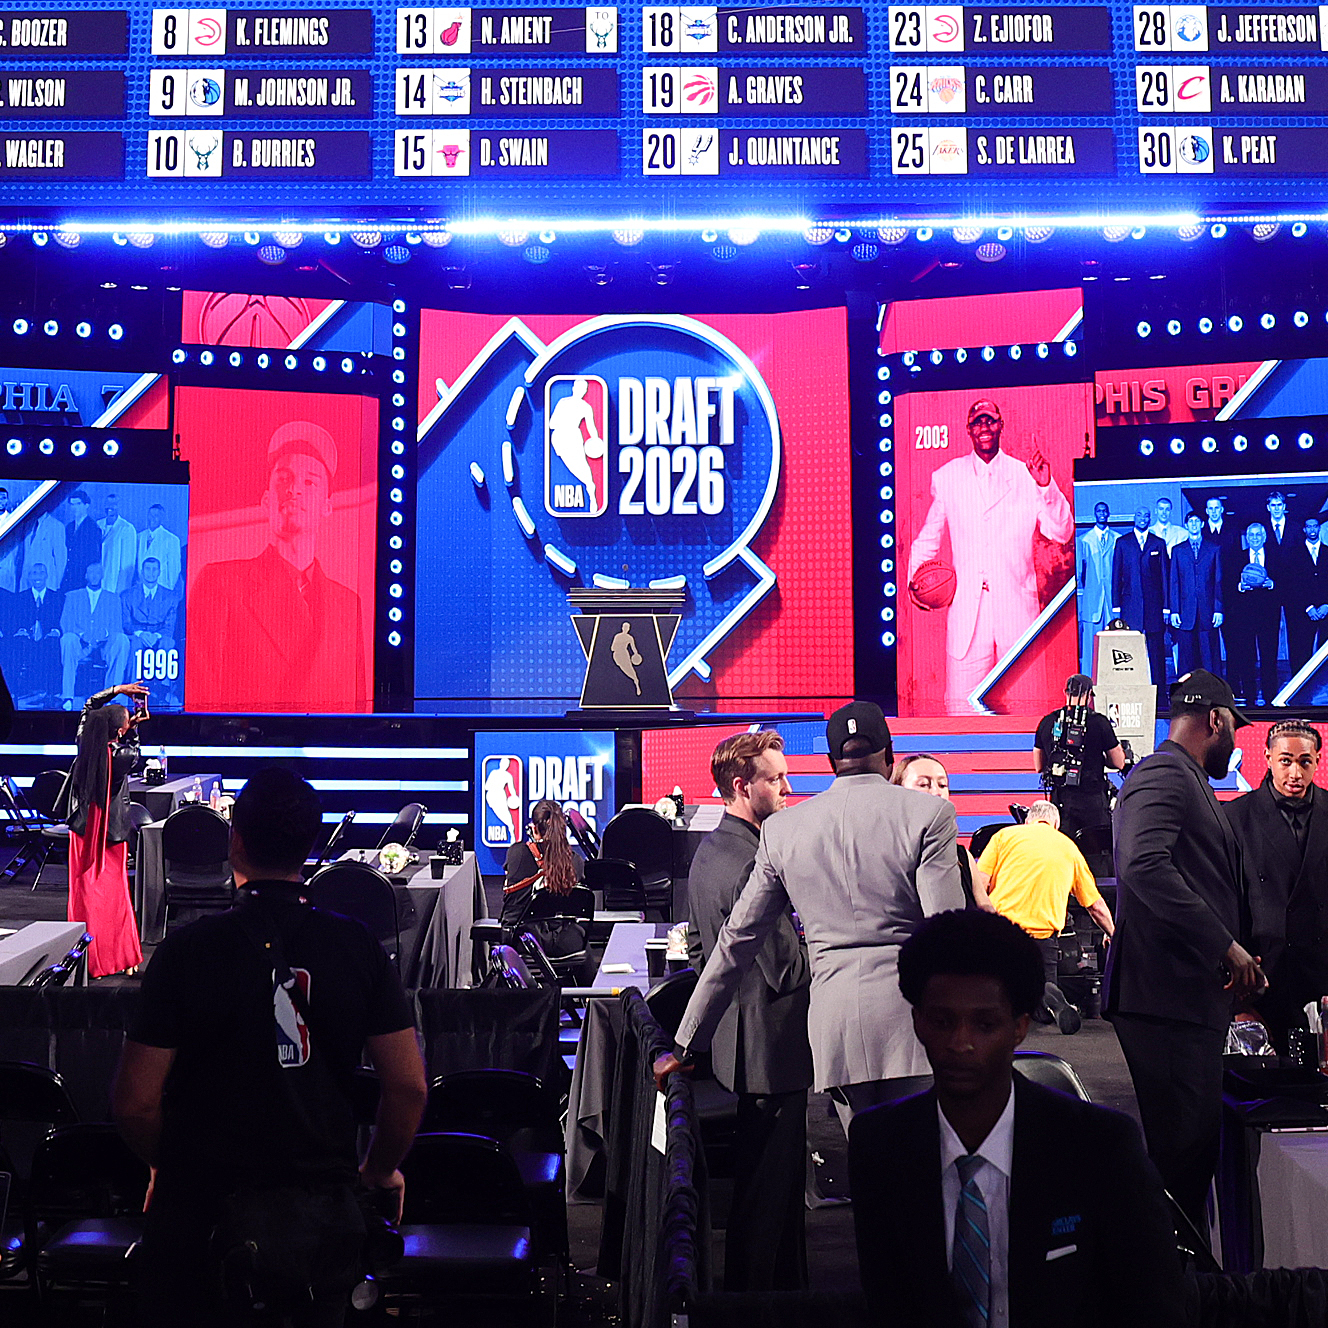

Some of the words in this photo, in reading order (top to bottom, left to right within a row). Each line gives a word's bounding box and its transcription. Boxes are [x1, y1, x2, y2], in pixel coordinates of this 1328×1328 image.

[11, 19, 69, 48] BOOZER
[164, 14, 178, 48] 8
[237, 18, 252, 47] K.
[255, 18, 330, 47] FLEMINGS
[403, 13, 428, 47] 13
[482, 17, 498, 46] N.
[501, 17, 554, 46] AMENT
[594, 11, 609, 21] TO
[650, 12, 674, 46] 18
[728, 16, 743, 45] C.
[746, 16, 826, 45] ANDERSON
[829, 16, 854, 45] JR.
[895, 11, 922, 46] 23
[974, 15, 989, 44] Z.
[991, 15, 1054, 44] EJIOFOR
[1139, 11, 1167, 45] 28
[1218, 15, 1233, 44] J.
[1236, 15, 1318, 44] JEFFERSON
[9, 79, 67, 108] WILSON
[162, 74, 176, 110] 9
[235, 79, 254, 107] M.
[257, 78, 329, 108] JOHNSON
[331, 78, 357, 107] JR.
[402, 74, 427, 109] 14
[482, 78, 497, 106] H.
[500, 77, 583, 106] STEINBACH
[650, 72, 675, 108] 19
[728, 76, 744, 105] A.
[747, 76, 804, 106] GRAVES
[897, 72, 924, 107] 24
[976, 75, 991, 105] C.
[994, 75, 1035, 105] CARR
[1142, 71, 1169, 106] 29
[1221, 75, 1236, 104] A.
[1238, 75, 1306, 104] KARABAN
[6, 140, 65, 169] WAGLER
[155, 135, 179, 171] 10
[233, 140, 248, 169] B.
[252, 139, 316, 169] BURRIES
[401, 135, 426, 170] 15
[481, 139, 497, 168] D.
[499, 138, 549, 168] SWAIN
[647, 134, 674, 169] 20
[729, 138, 745, 167] J.
[748, 137, 841, 167] QUAINTANCE
[898, 133, 925, 169] 25
[977, 136, 993, 166] S.
[996, 137, 1017, 166] DE
[1019, 136, 1076, 166] LARREA
[1144, 132, 1172, 167] 30
[1223, 136, 1239, 165] K.
[1241, 136, 1278, 165] PEAT
[618, 375, 742, 445] DRAFT
[915, 425, 949, 450] 2003
[553, 484, 585, 508] NBA
[618, 445, 725, 515] 2026
[134, 648, 179, 680] 1996
[528, 755, 608, 801] DRAFT
[487, 825, 508, 841] NBA
